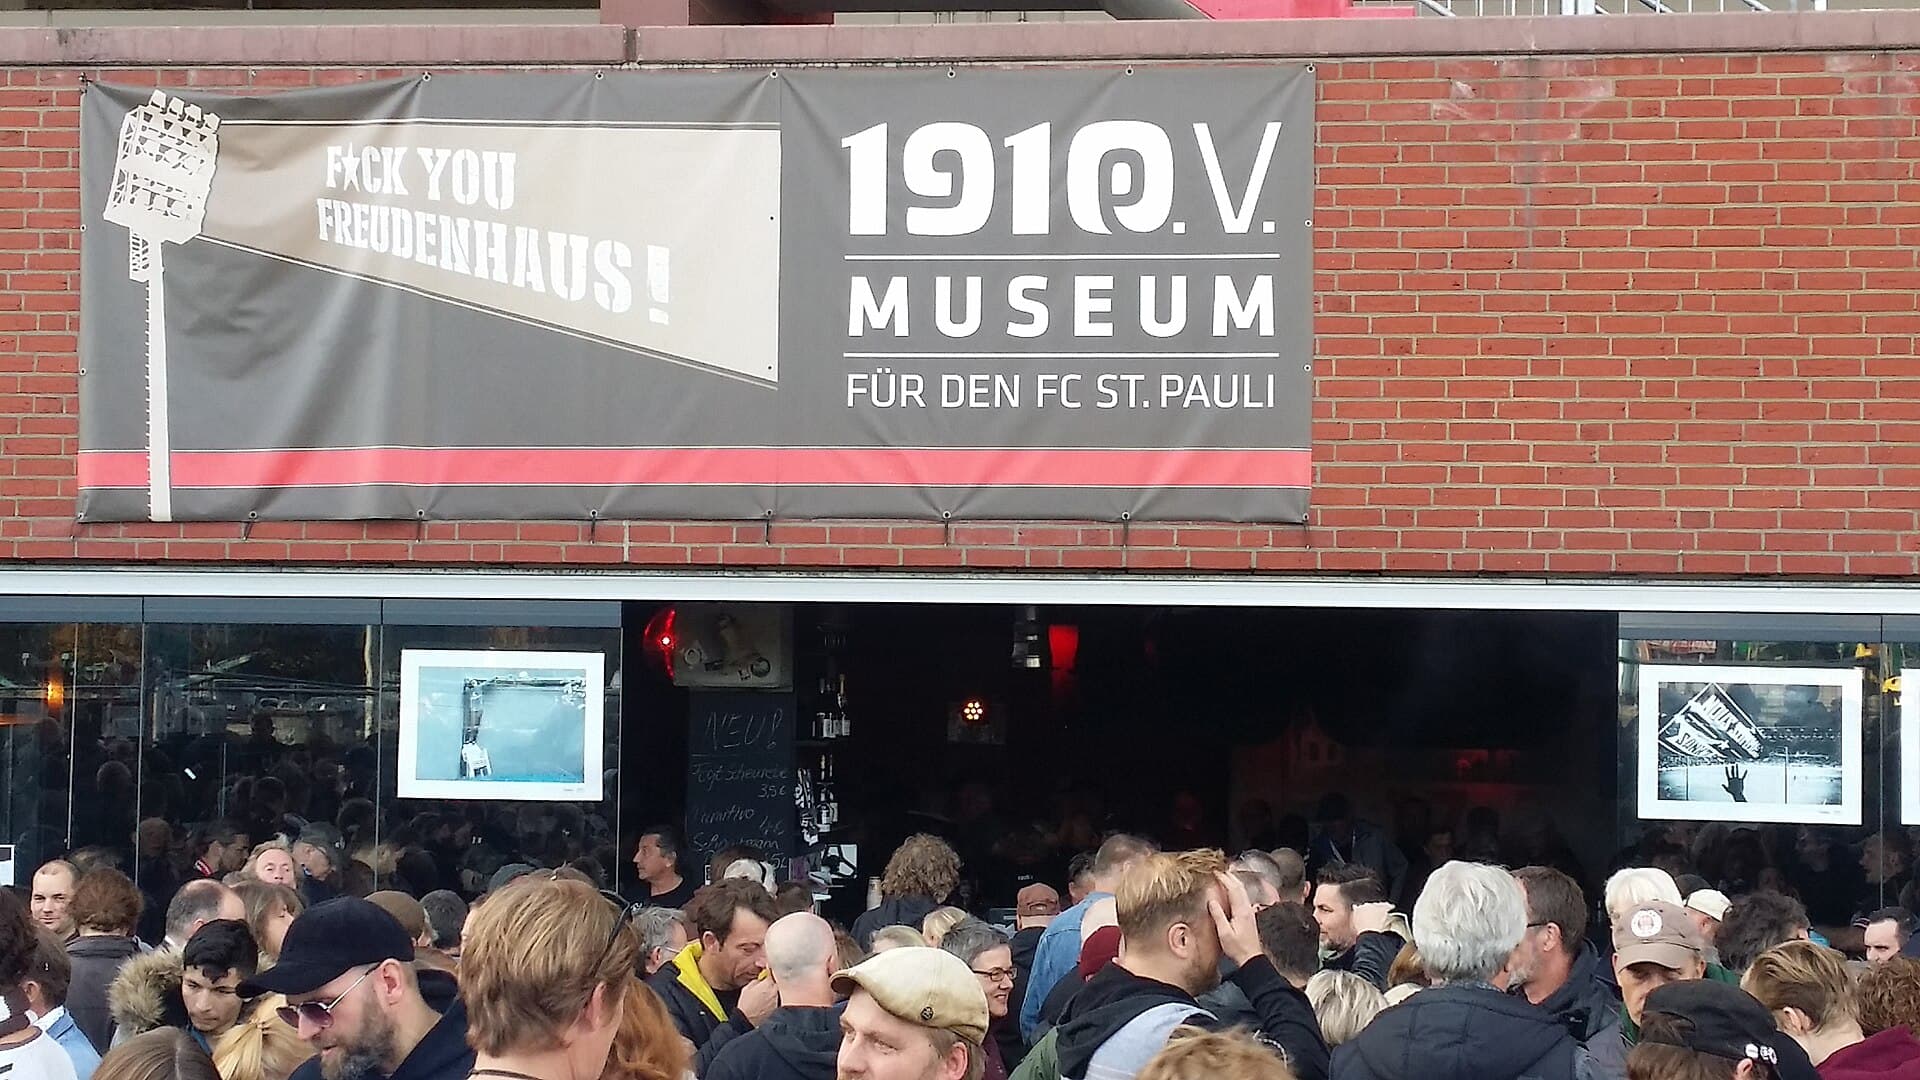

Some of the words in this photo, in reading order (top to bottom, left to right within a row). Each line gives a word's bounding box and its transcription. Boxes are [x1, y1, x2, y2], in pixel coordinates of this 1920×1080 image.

[416, 147, 516, 211] YOU
[847, 274, 1276, 339] MUSEUM
[846, 367, 926, 409] FÜR
[940, 373, 1021, 409] DEN
[1036, 373, 1082, 409] FC
[1095, 373, 1150, 409] ST.
[1160, 373, 1275, 409] PAULI
